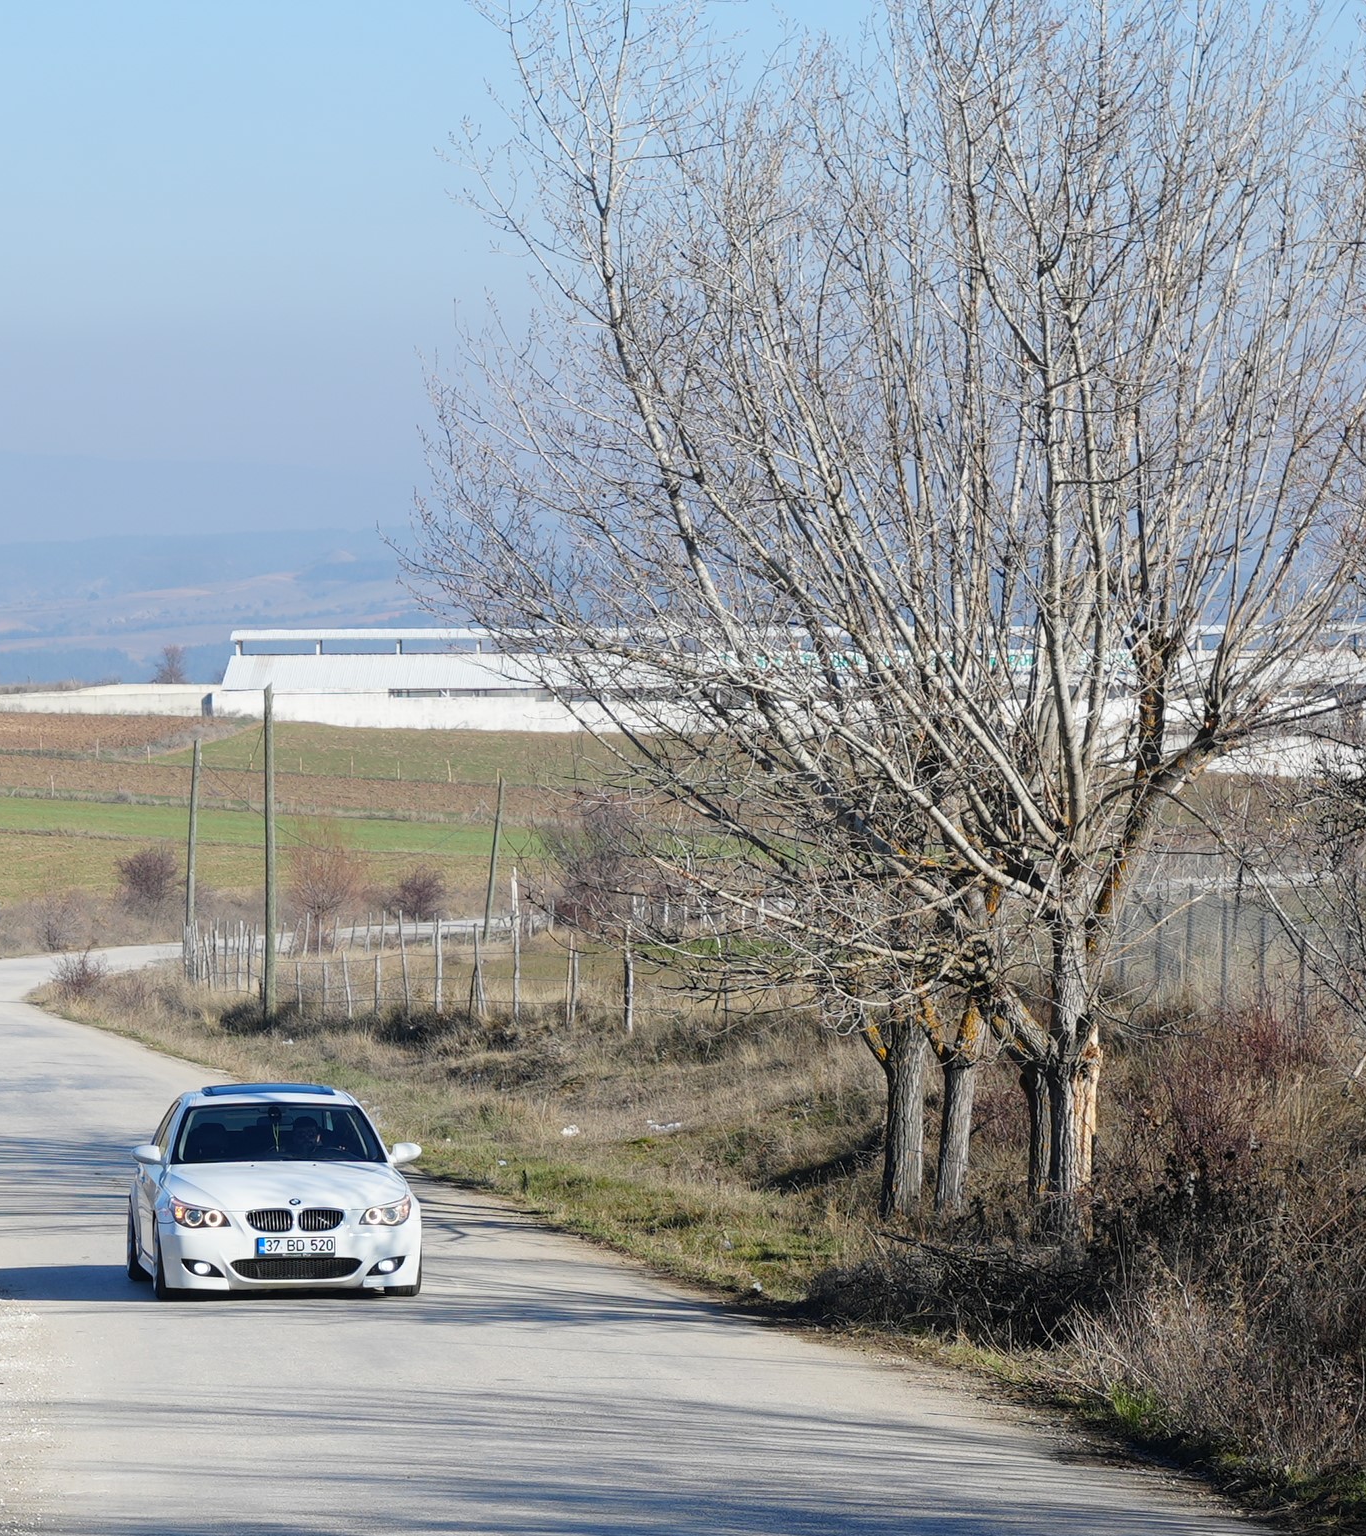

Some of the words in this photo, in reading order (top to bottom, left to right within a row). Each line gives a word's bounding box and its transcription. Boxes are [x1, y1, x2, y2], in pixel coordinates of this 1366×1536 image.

[265, 1239, 280, 1252] 37
[287, 1239, 305, 1252] BD
[310, 1239, 334, 1252] 520
